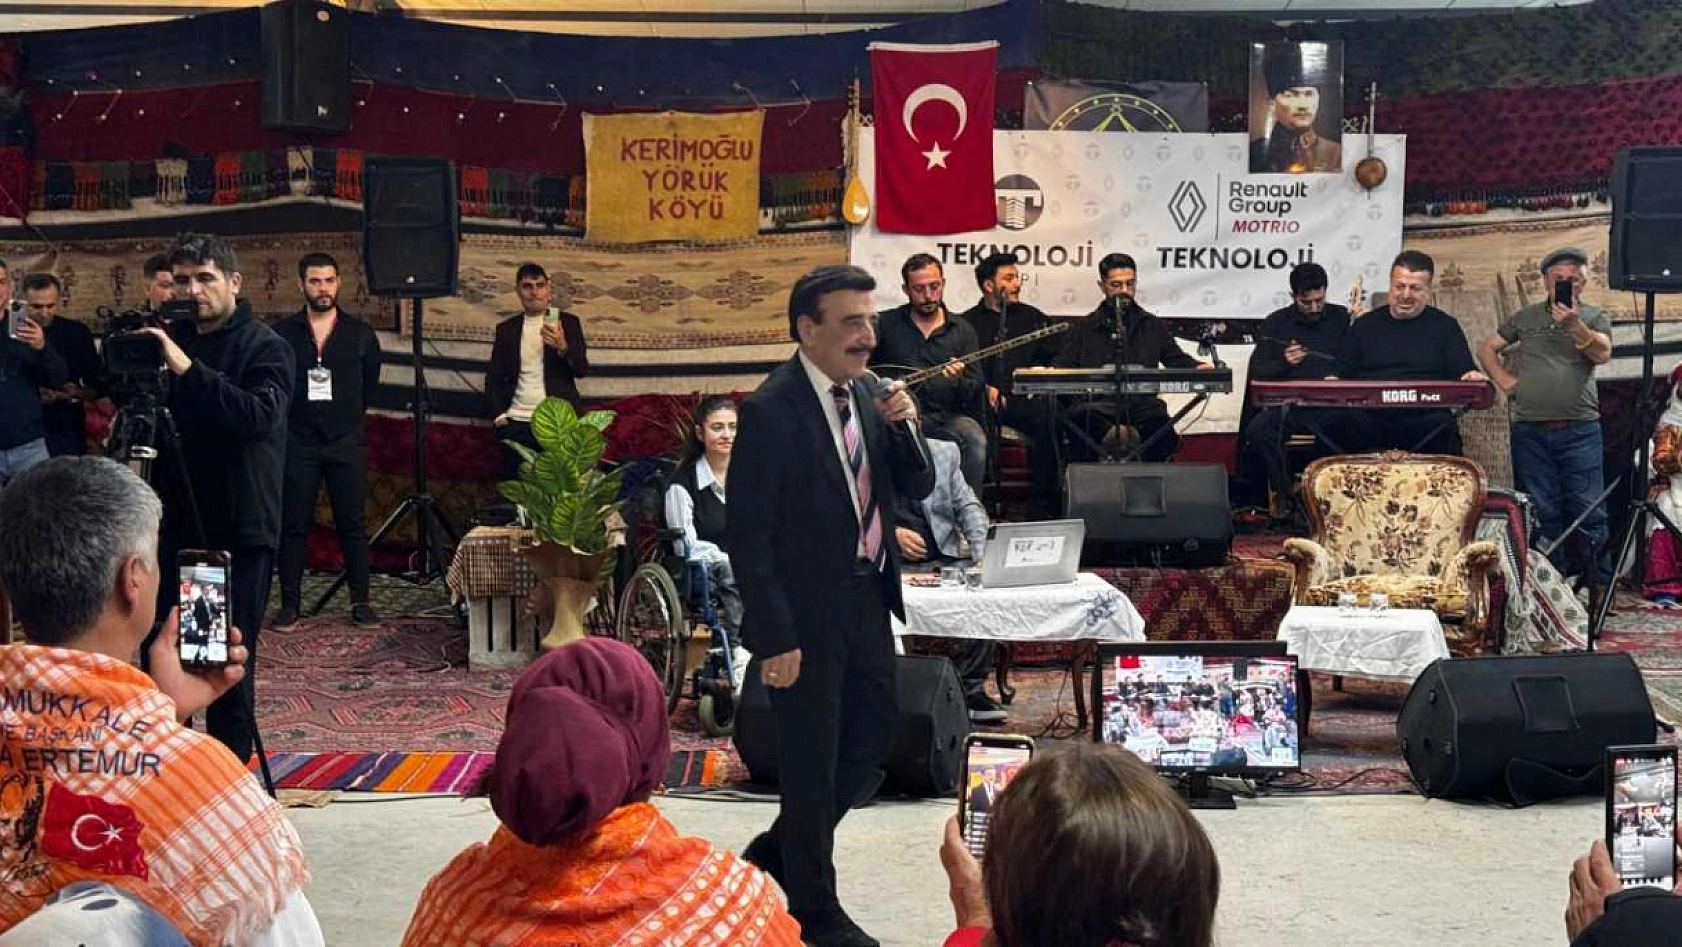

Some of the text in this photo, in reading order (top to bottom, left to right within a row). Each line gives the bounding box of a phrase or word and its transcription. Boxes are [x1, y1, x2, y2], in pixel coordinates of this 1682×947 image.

[620, 134, 754, 163] KERİMOĞLU
[642, 163, 729, 193] YÖRÜK
[1228, 180, 1309, 198] Renault
[648, 196, 725, 222] KÖYÜ
[1228, 198, 1292, 217] Group
[1231, 220, 1301, 233] MOTRIO
[1156, 243, 1315, 269] TEKNOLOJİ
[1158, 380, 1190, 392] KORG
[1381, 388, 1418, 403] KORG
[24, 725, 103, 745] BAŞKANI
[21, 747, 161, 777] ERTEMUR
